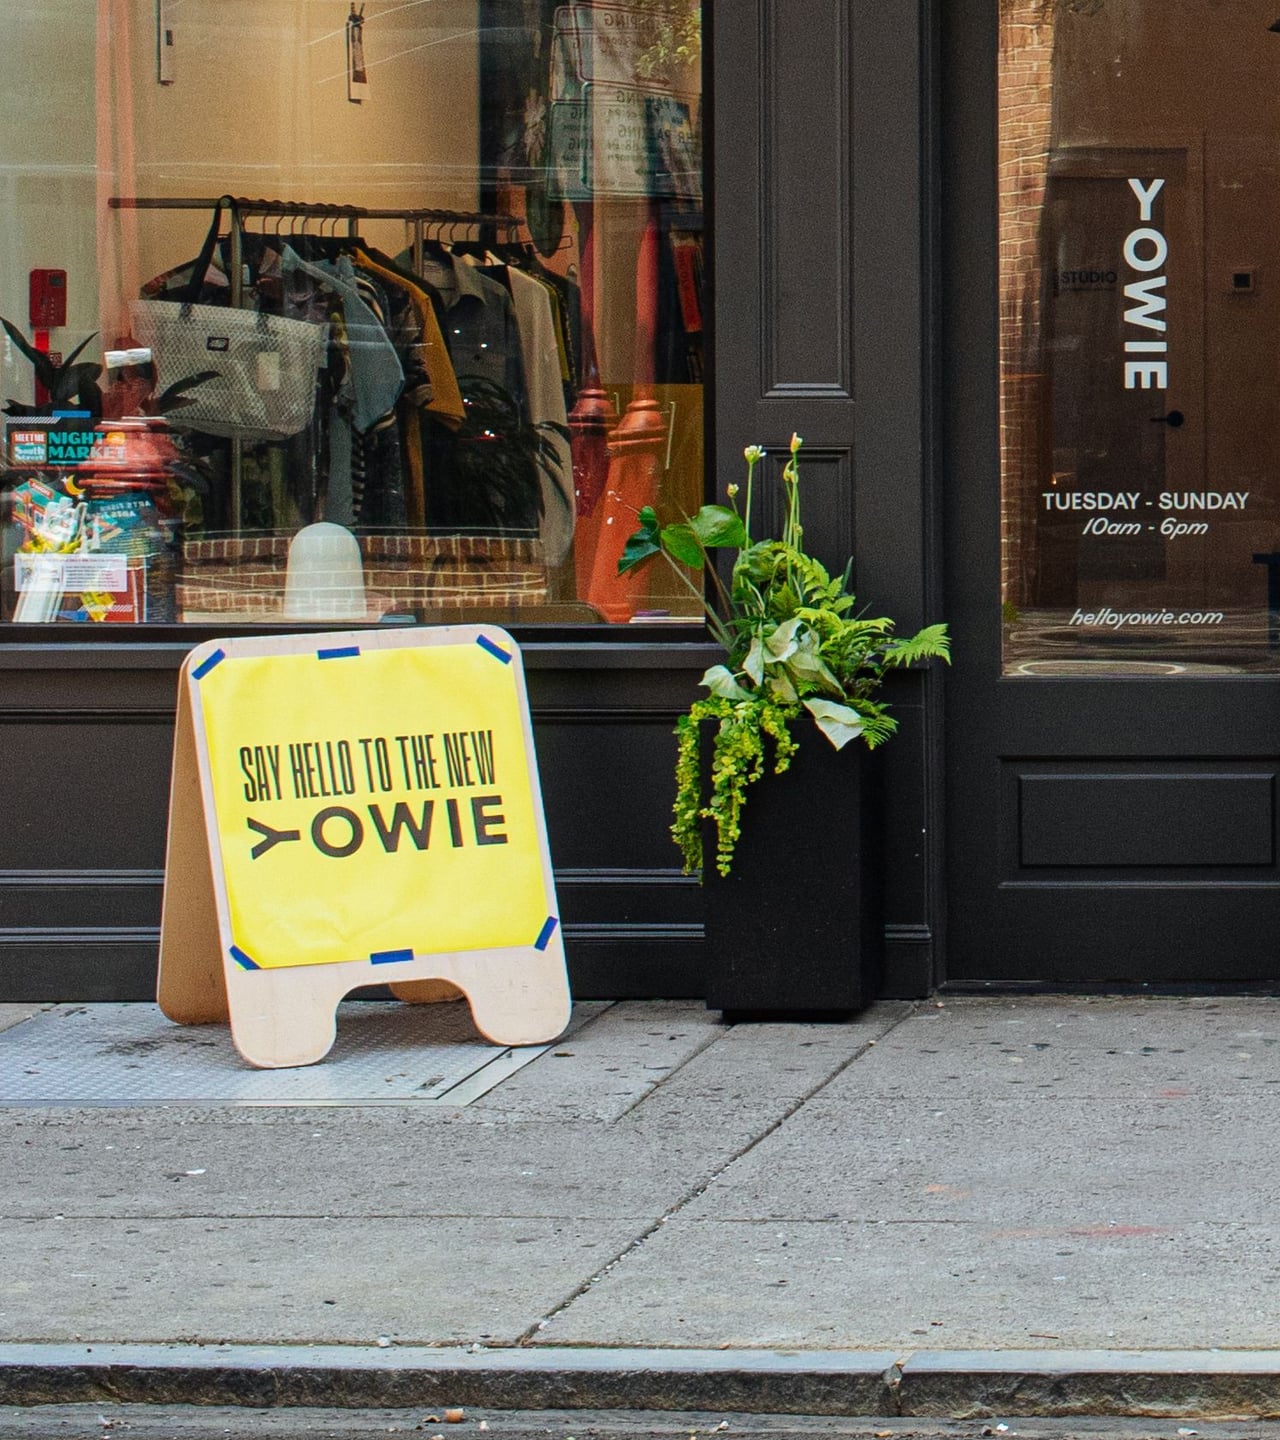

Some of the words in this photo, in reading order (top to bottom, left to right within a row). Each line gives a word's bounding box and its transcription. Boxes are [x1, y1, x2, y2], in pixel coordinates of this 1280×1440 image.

[1061, 271, 1118, 284] STUDIO
[1123, 178, 1168, 389] YOWIE
[48, 432, 105, 445] NIGHT
[48, 446, 126, 459] MARKET
[1042, 492, 1140, 510] TUESDAY
[1158, 491, 1249, 510] SUNDAY
[1082, 517, 1142, 535] 10am
[1160, 517, 1209, 540] 6pm
[1068, 608, 1224, 630] helloyowie.com
[239, 744, 283, 802] SAY
[288, 740, 356, 799] HELLO
[358, 737, 393, 793] TO
[395, 734, 441, 791] THE
[442, 729, 496, 788] NEW
[246, 794, 508, 860] YOWIE
